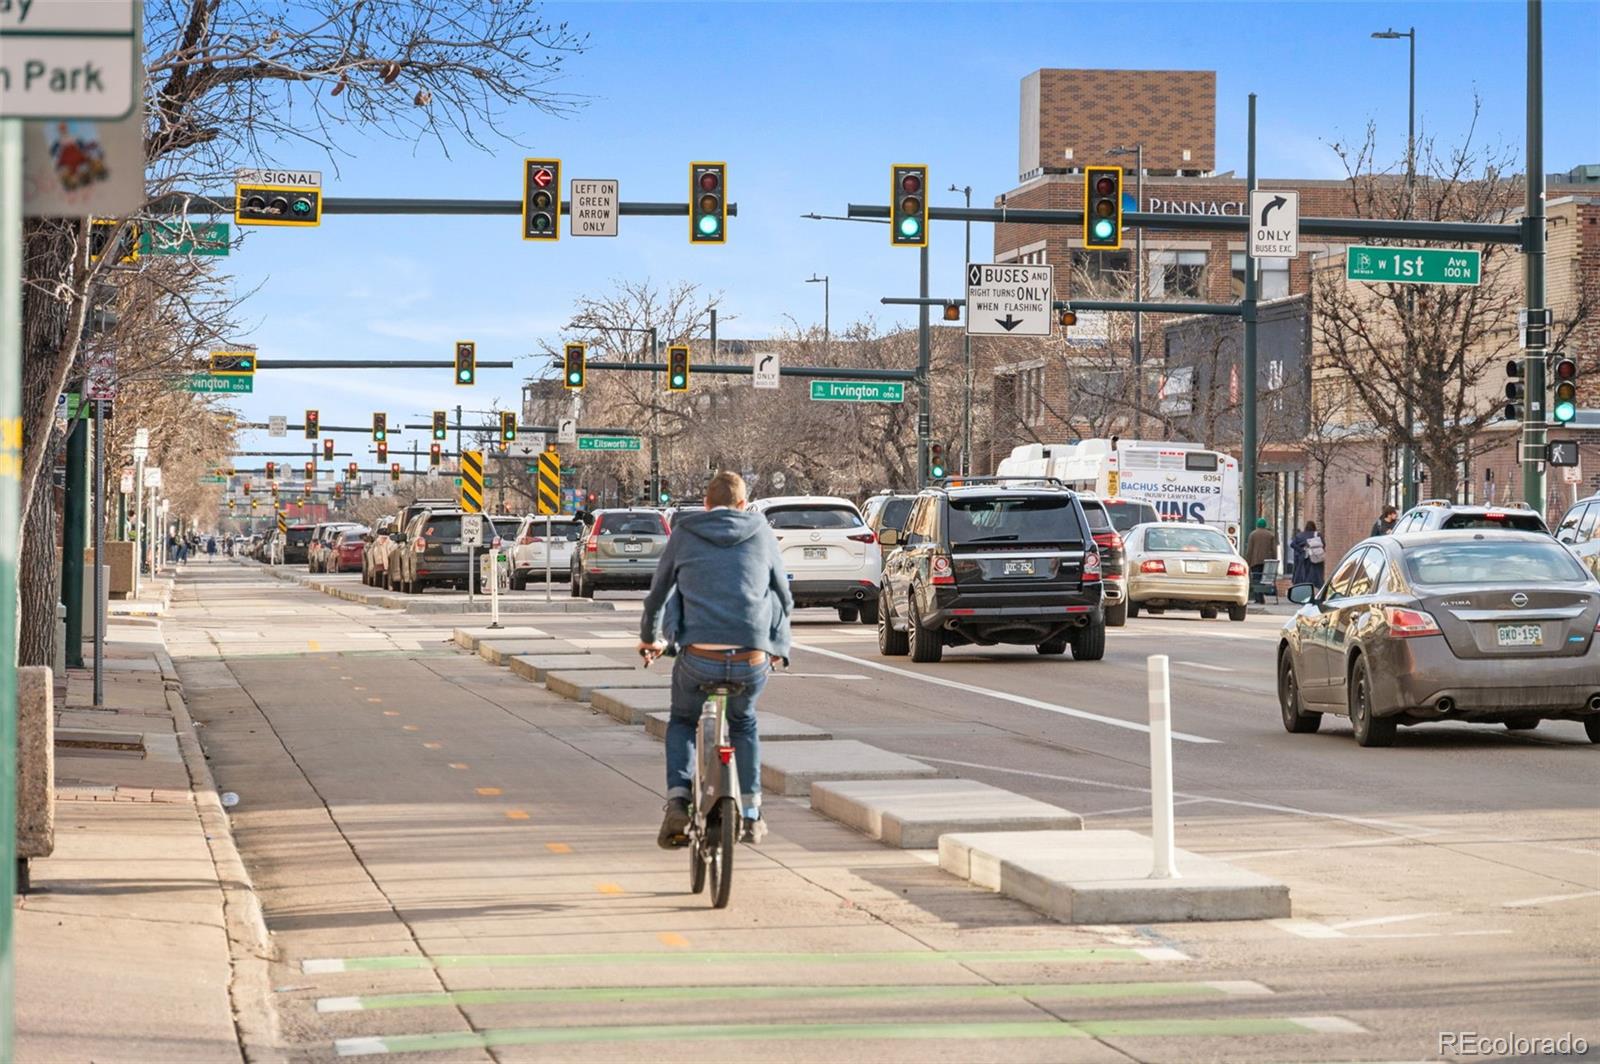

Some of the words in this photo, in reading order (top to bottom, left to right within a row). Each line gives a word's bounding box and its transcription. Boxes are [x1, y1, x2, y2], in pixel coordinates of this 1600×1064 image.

[24, 59, 105, 93] Park
[264, 172, 317, 185] SIGNAL
[575, 184, 597, 194] LEFT
[601, 184, 614, 194] ON
[579, 196, 610, 206] GREEN
[578, 209, 610, 219] ARROW
[582, 221, 605, 231] ONLY
[1257, 230, 1291, 241] ONLY
[1255, 244, 1277, 253] BUSES
[1279, 244, 1292, 253] EXC
[1393, 254, 1424, 276] 1st
[1447, 257, 1467, 267] Ave
[985, 268, 1029, 283] BUSES
[1031, 272, 1048, 281] AND
[1444, 267, 1461, 277] 100
[1463, 268, 1471, 278] N
[970, 288, 990, 297] RIGHT
[993, 288, 1016, 298] TURNS
[1017, 286, 1049, 301] ONLY
[976, 302, 999, 311] WHEN
[1004, 303, 1043, 312] FLASHING
[830, 384, 879, 400] Irvington
[594, 440, 627, 448] Ellsworth
[1121, 482, 1159, 491] BACHUS
[1161, 484, 1211, 494] SCHANKER
[1155, 500, 1206, 524] INS
